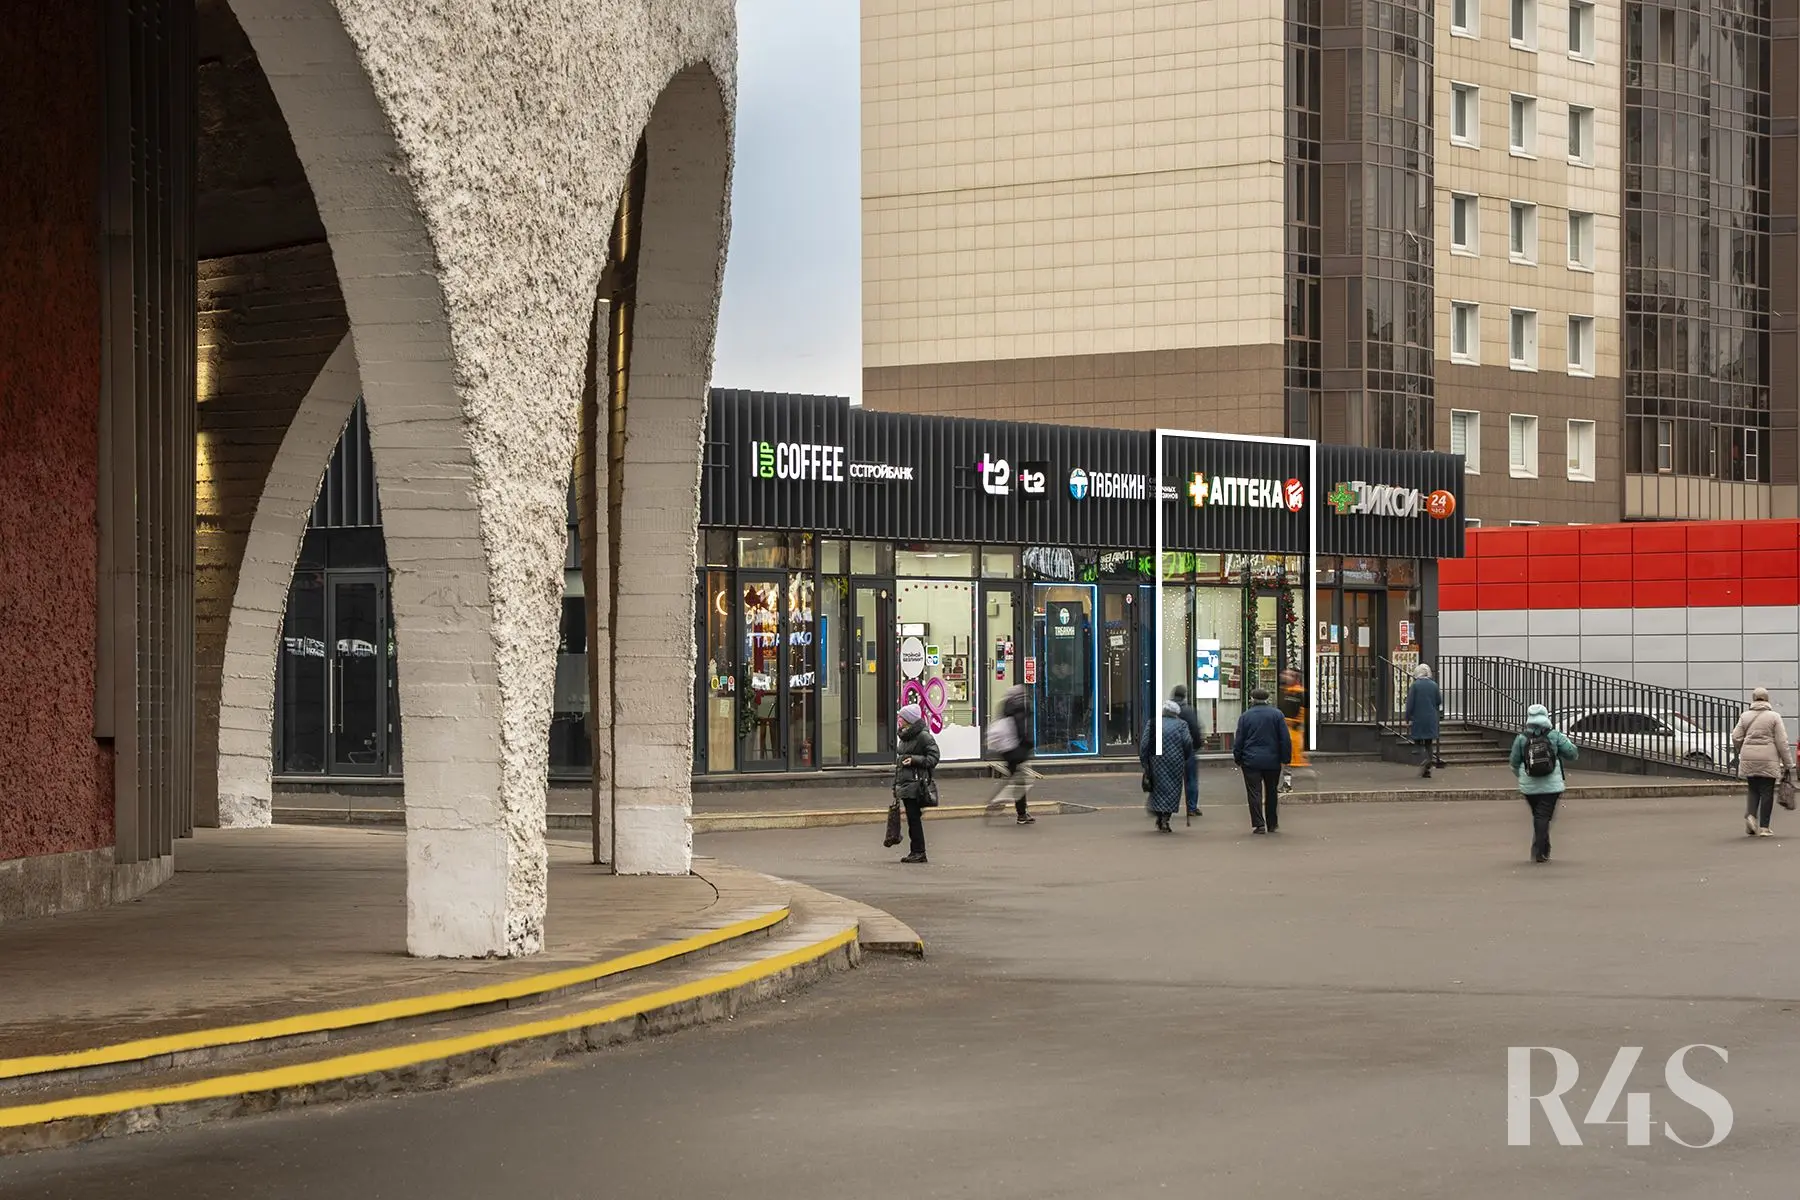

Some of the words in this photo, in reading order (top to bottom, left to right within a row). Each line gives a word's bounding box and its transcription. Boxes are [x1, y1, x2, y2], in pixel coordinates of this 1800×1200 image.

[760, 441, 775, 478] CUP
[777, 442, 844, 482] COFFEE
[983, 453, 1010, 495] t2
[1023, 469, 1045, 493] t2
[1089, 471, 1145, 500] ТАБАКИН
[1209, 476, 1284, 509] АПТЕКА
[1350, 481, 1418, 518] ДИКСИ
[1431, 494, 1447, 506] 24
